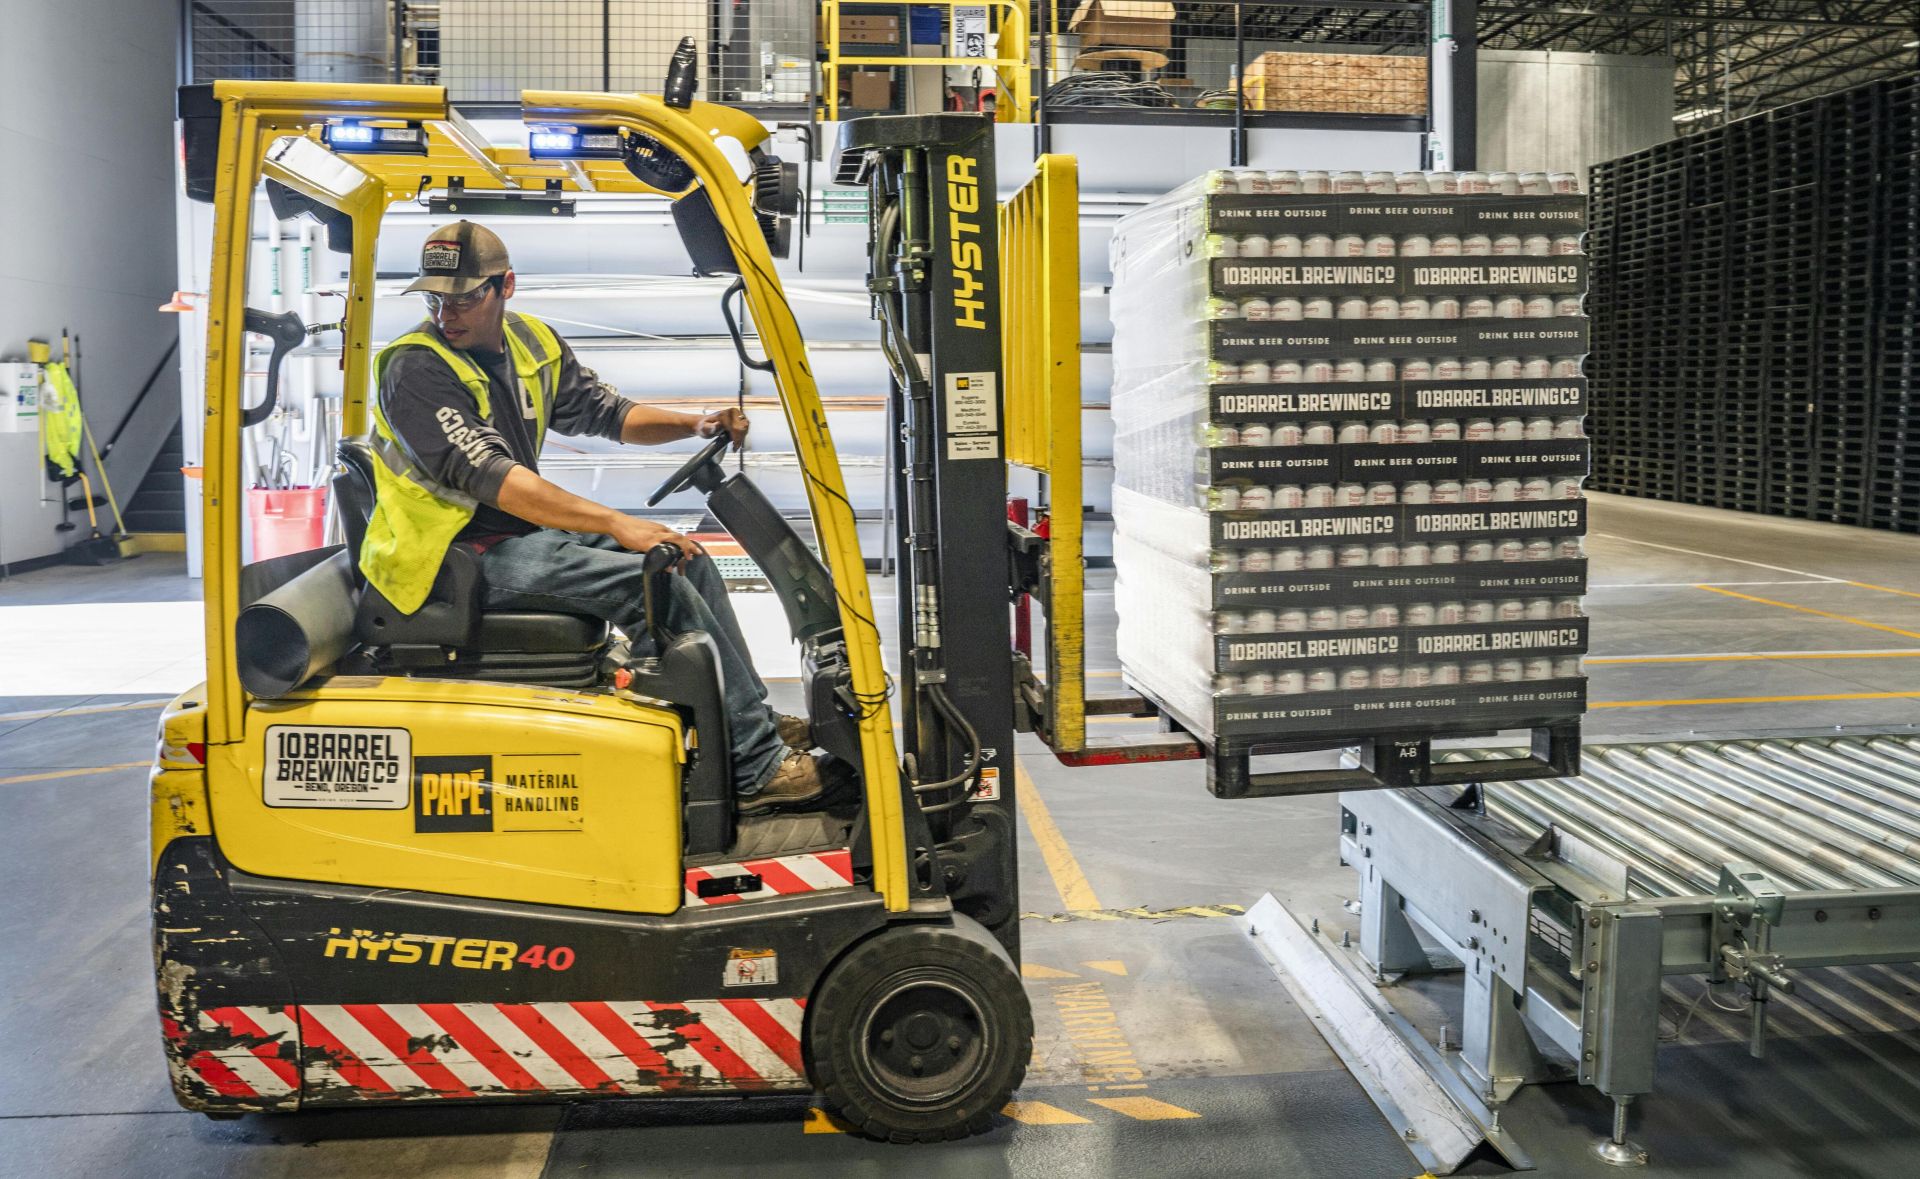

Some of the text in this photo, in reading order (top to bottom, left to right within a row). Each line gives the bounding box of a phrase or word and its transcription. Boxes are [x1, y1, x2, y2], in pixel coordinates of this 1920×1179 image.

[956, 16, 965, 43] LEDGE
[1218, 209, 1327, 218] DRINK BEER OUTSIDE
[1349, 207, 1454, 215] DRINK BEER OUTSIDE
[1478, 211, 1581, 220] DRINK BEER OUTSIDE
[946, 154, 986, 330] HYSTER
[1302, 267, 1374, 284] BREWING
[1489, 267, 1557, 284] BREWING
[1222, 337, 1330, 346] DRINK BEER OUTSIDE
[1353, 336, 1458, 345] DRINK BEER OUTSIDE
[1478, 330, 1579, 340] DRINK BEER OUTSIDE
[1298, 393, 1369, 411] BREWING
[1491, 388, 1559, 406] BREWING
[1221, 458, 1329, 469] DRINK BEER OUTSIDE
[1353, 456, 1458, 467] DRINK BEER OUTSIDE
[1480, 453, 1581, 464] DRINK BEER OUTSIDE
[1301, 517, 1372, 537] BREWING
[1490, 511, 1558, 530] BREWING
[1352, 576, 1455, 588] DRINK BEER OUTSIDE
[1479, 575, 1579, 587] DRINK BEER OUTSIDE
[1223, 583, 1331, 595] DRINK BEER OUTSIDE
[1491, 630, 1558, 650] BREWING
[1307, 637, 1377, 658] BREWING
[1478, 691, 1578, 704] DRINK BEER OUTSIDE
[1353, 698, 1456, 711] DRINK BEER OUTSIDE
[1226, 708, 1332, 721] DRINK BEER OUTSIDE
[1399, 747, 1418, 758] A-B
[277, 759, 370, 782] BREWING
[334, 783, 369, 793] OREGON
[505, 796, 579, 812] HANDLING
[323, 927, 576, 971] HYSTER 40
